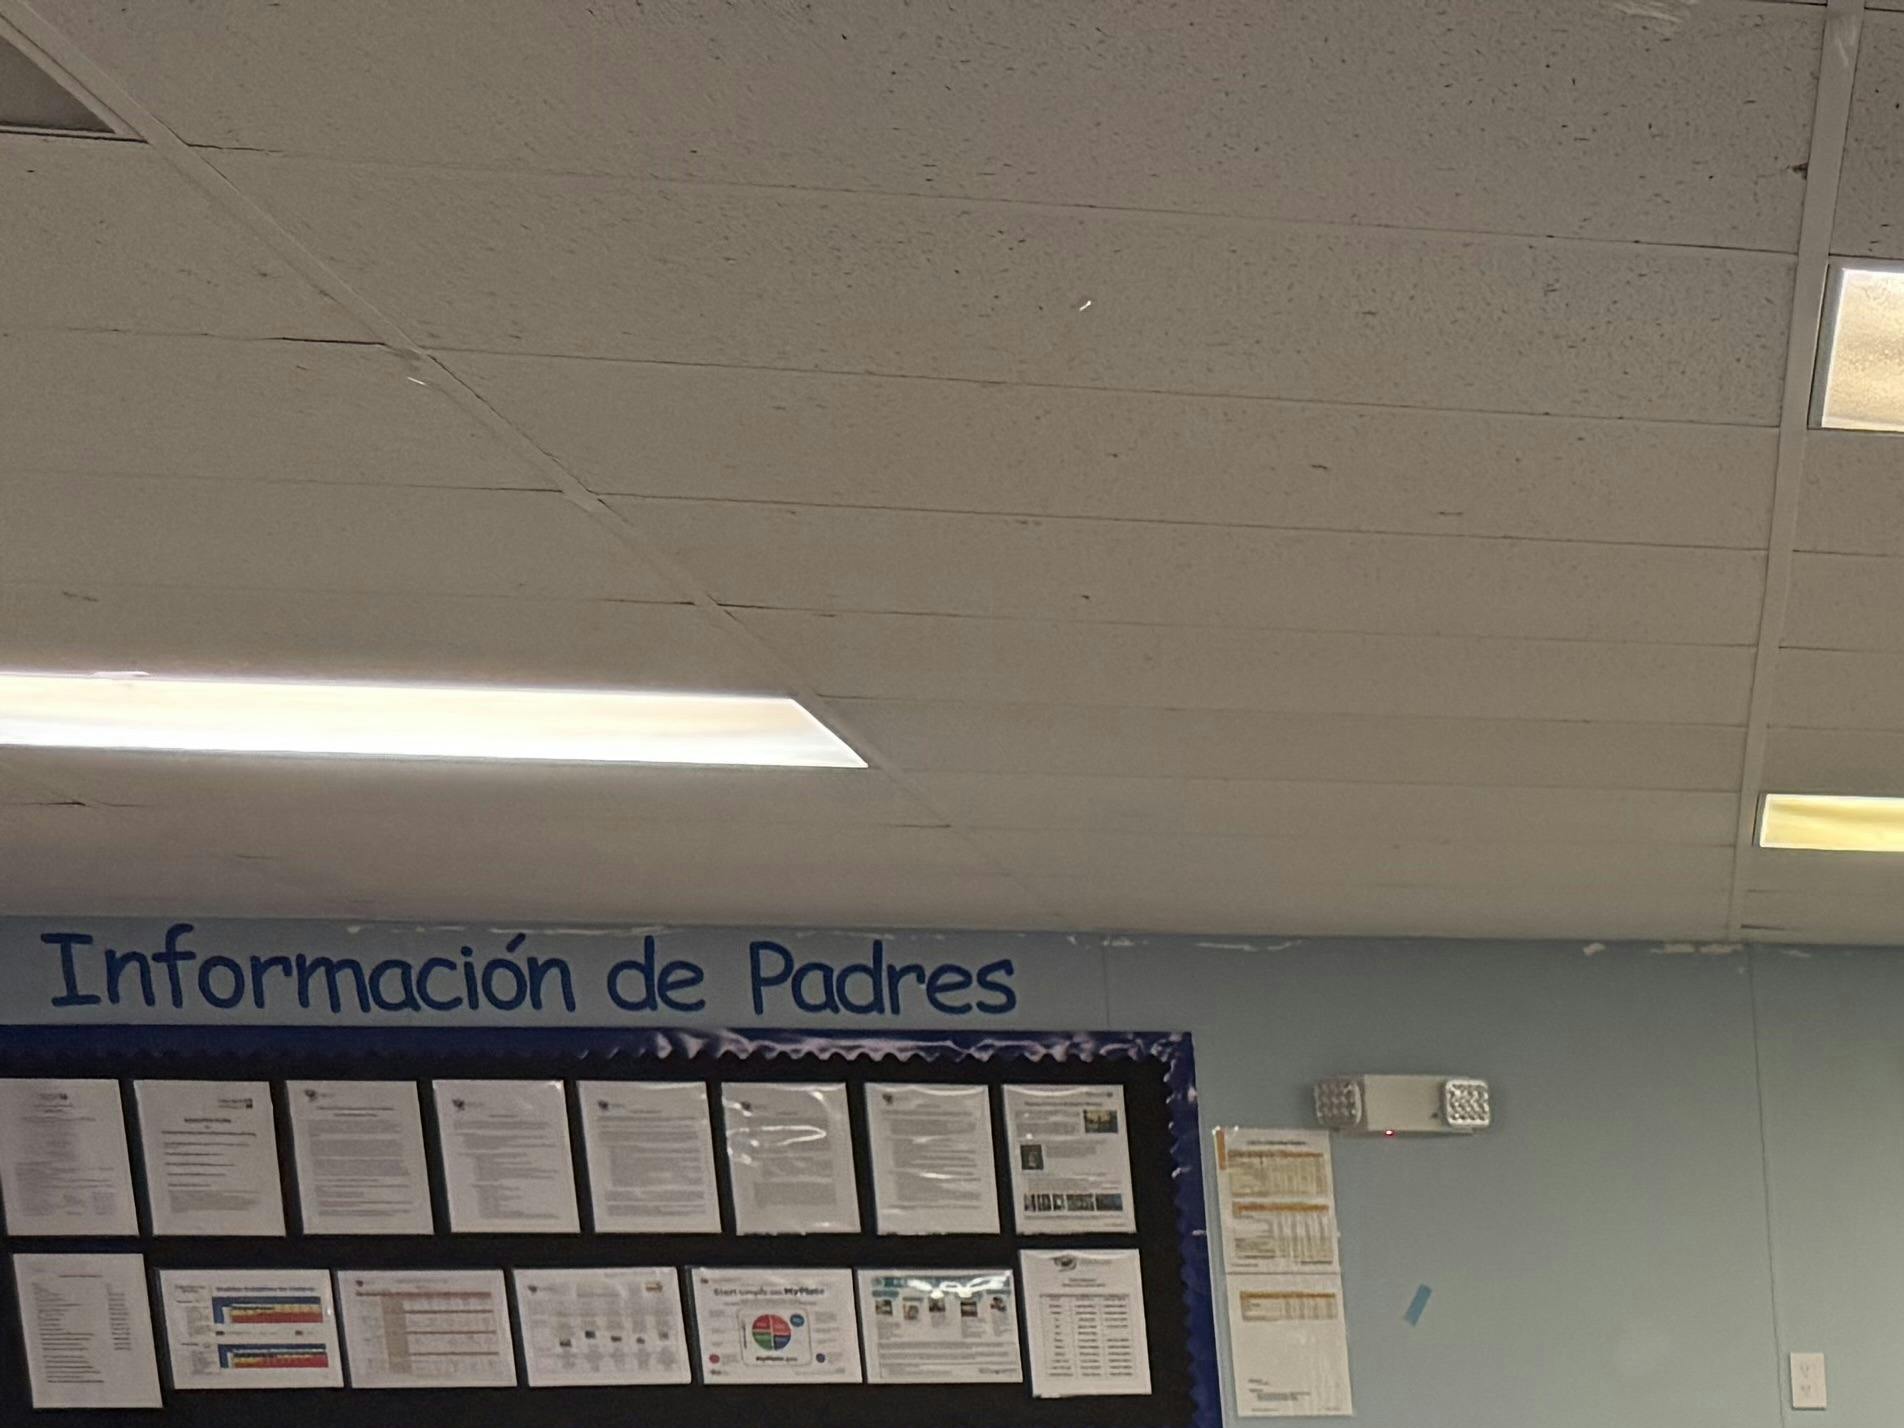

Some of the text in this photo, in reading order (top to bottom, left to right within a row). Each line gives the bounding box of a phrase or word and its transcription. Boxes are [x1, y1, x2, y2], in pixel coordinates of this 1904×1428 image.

[40, 923, 1018, 1017] Información de Padres
